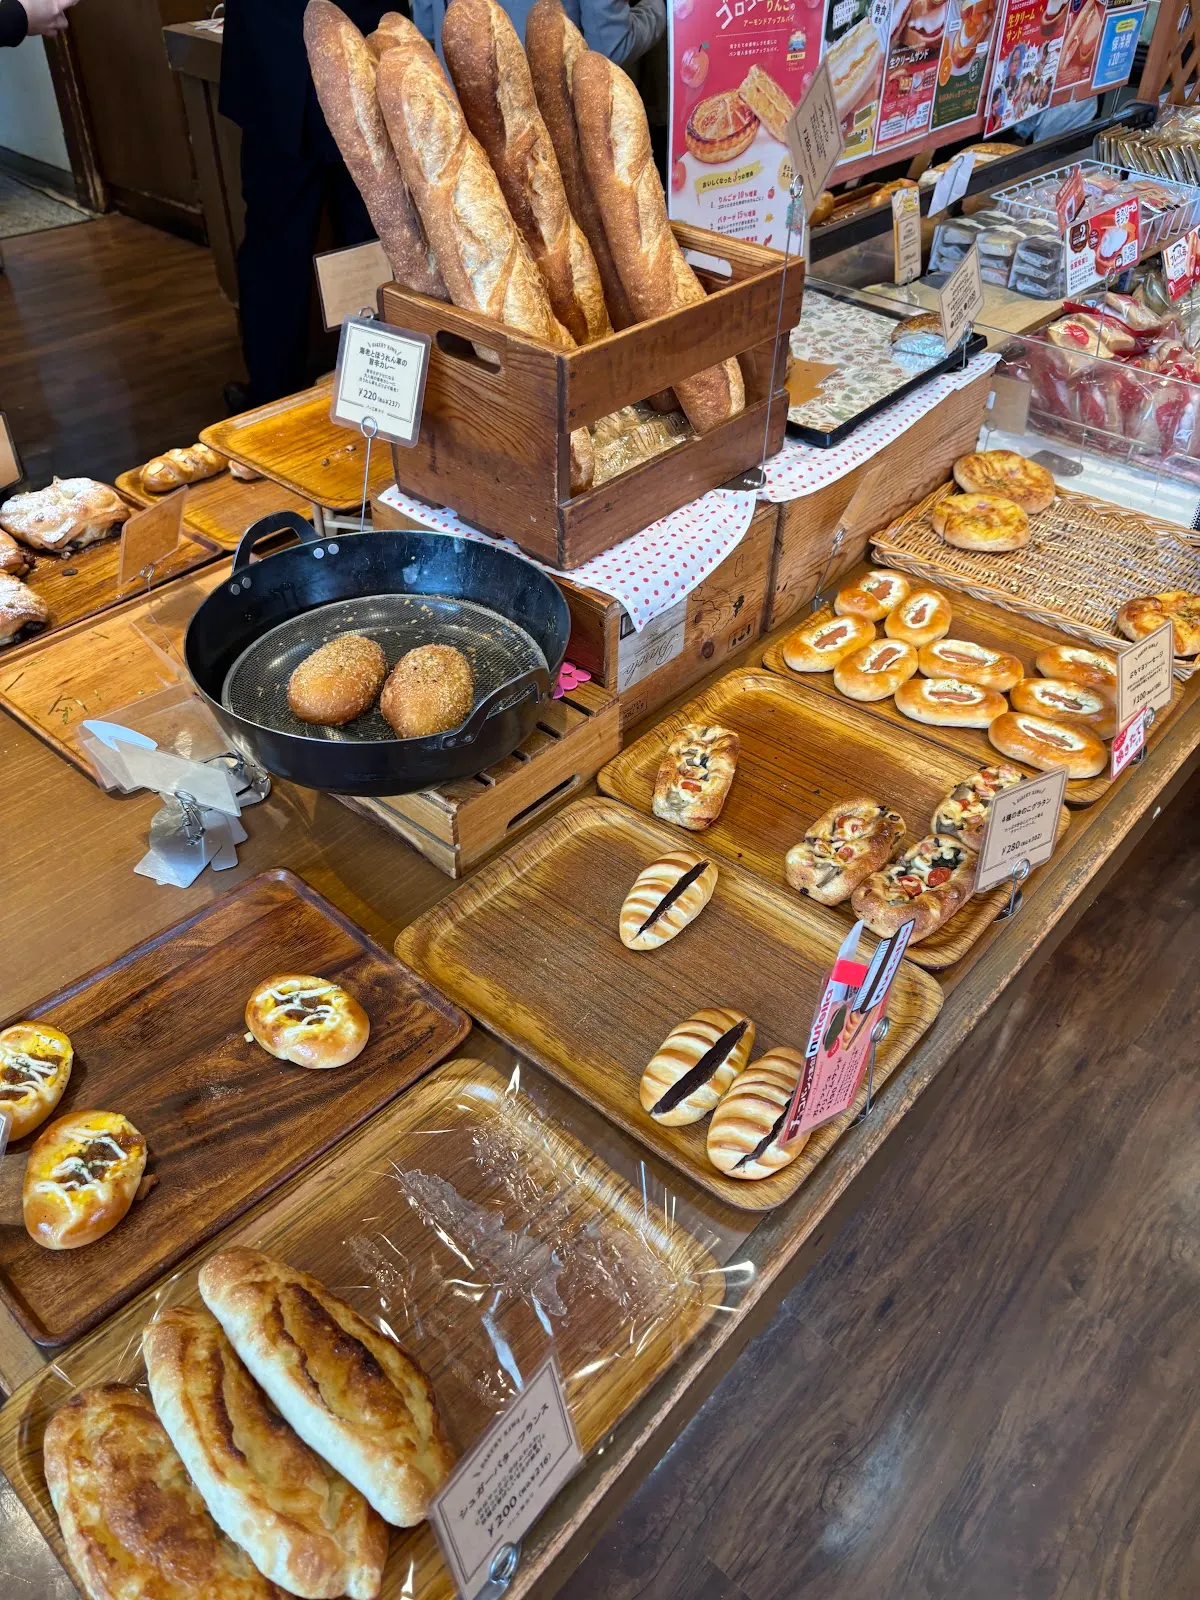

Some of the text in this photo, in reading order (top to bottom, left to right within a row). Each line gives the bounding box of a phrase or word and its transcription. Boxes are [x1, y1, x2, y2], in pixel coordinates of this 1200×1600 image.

[743, 15, 795, 27] アーモンドアップルパイ
[889, 49, 930, 69] 生クリームサンド
[358, 387, 377, 401] ¥220
[459, 1403, 549, 1519] シュガーバターフランス
[488, 1496, 517, 1537] ¥200
